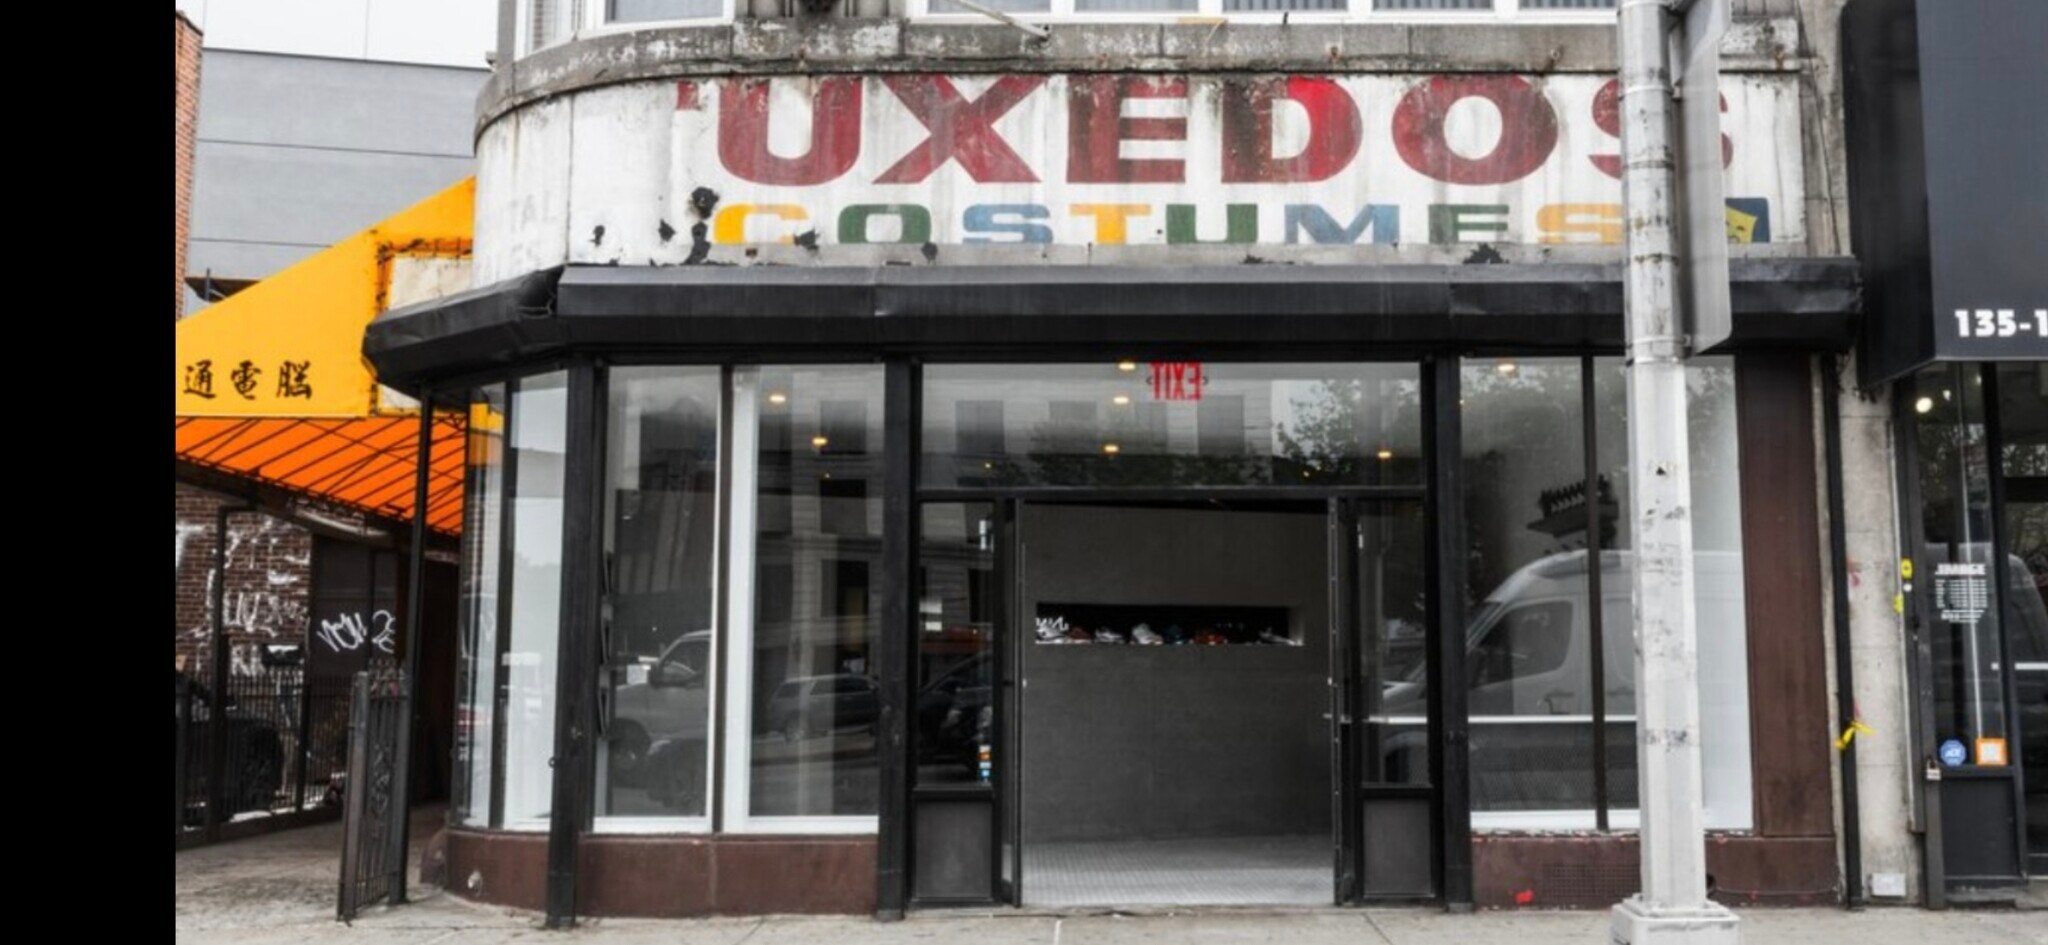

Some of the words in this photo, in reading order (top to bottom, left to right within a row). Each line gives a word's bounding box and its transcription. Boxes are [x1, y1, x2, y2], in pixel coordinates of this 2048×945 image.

[677, 74, 1734, 187] UXEDO
[713, 202, 1623, 245] COSTUMES
[1954, 309, 2048, 337] 135-1
